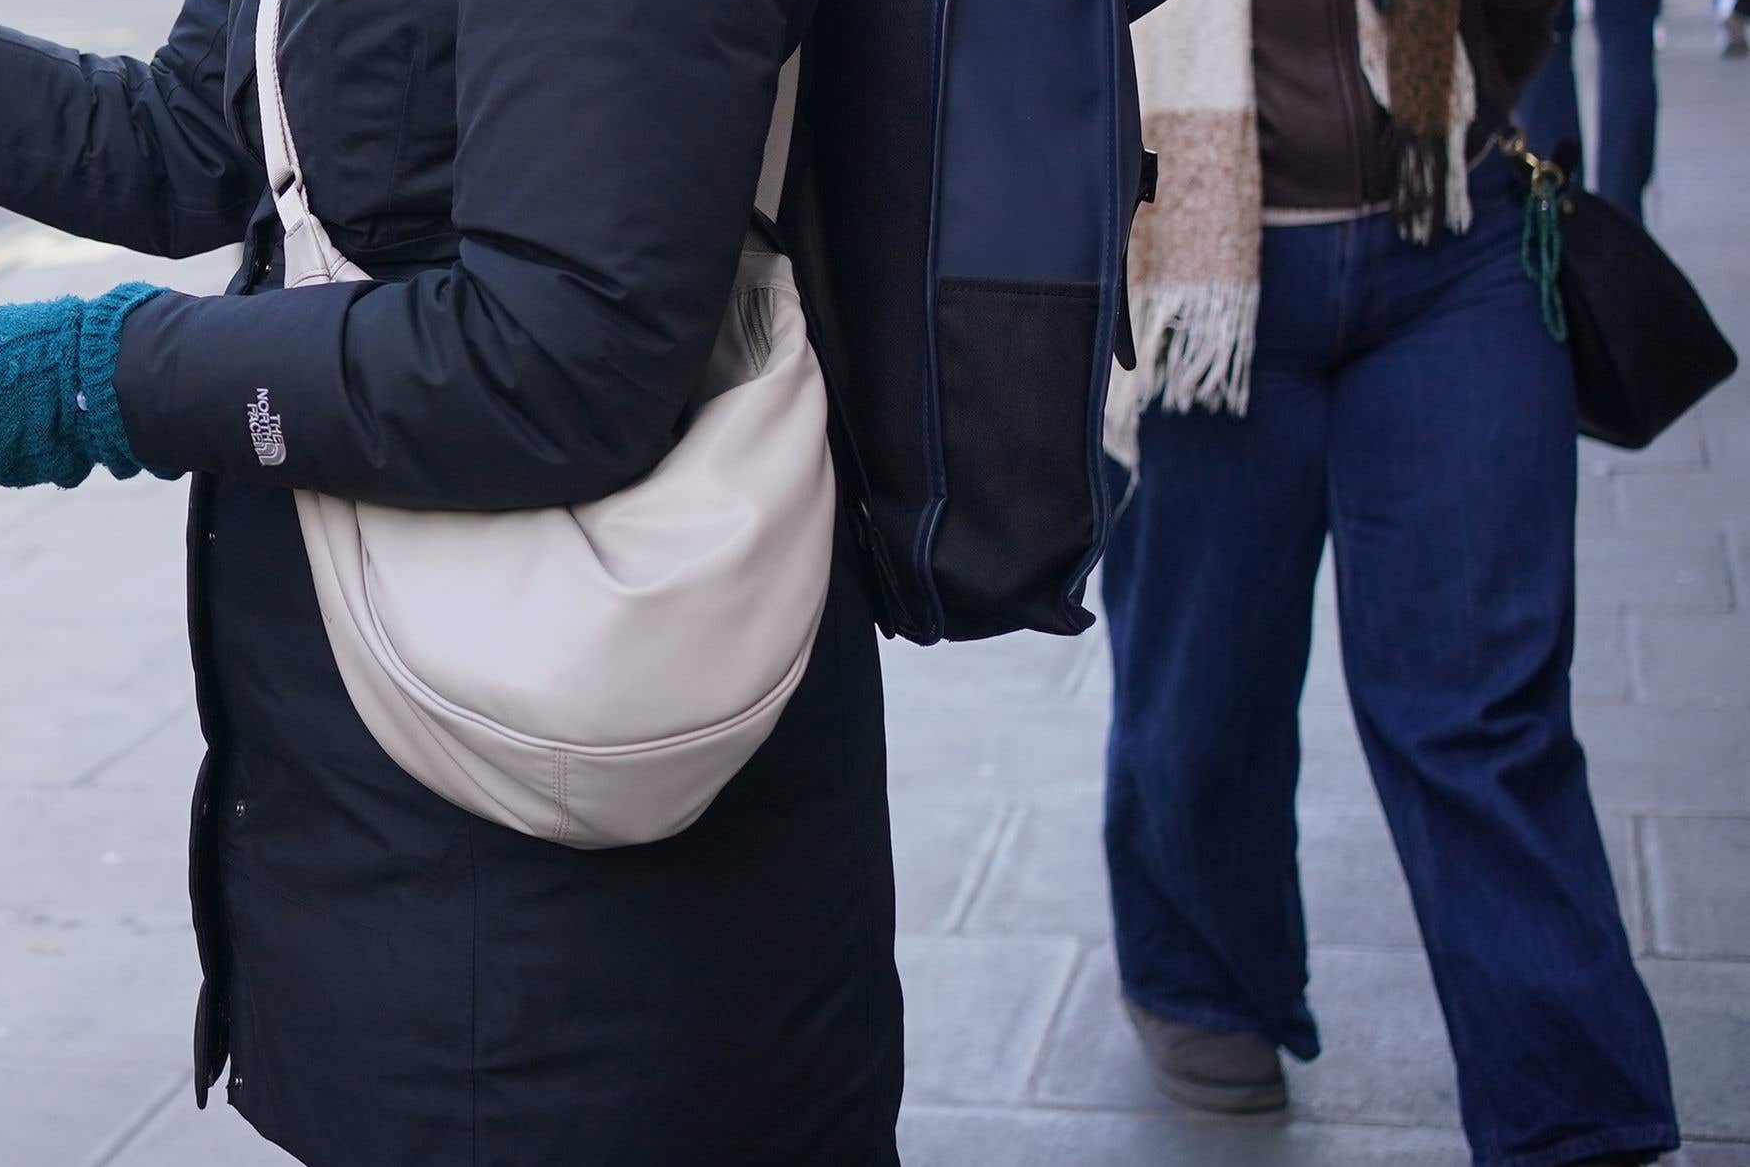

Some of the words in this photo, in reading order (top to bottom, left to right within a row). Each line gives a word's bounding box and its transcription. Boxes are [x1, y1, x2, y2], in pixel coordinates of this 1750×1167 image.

[247, 403, 262, 443] FACE
[257, 388, 273, 443] NORTH
[270, 414, 283, 445] THE
